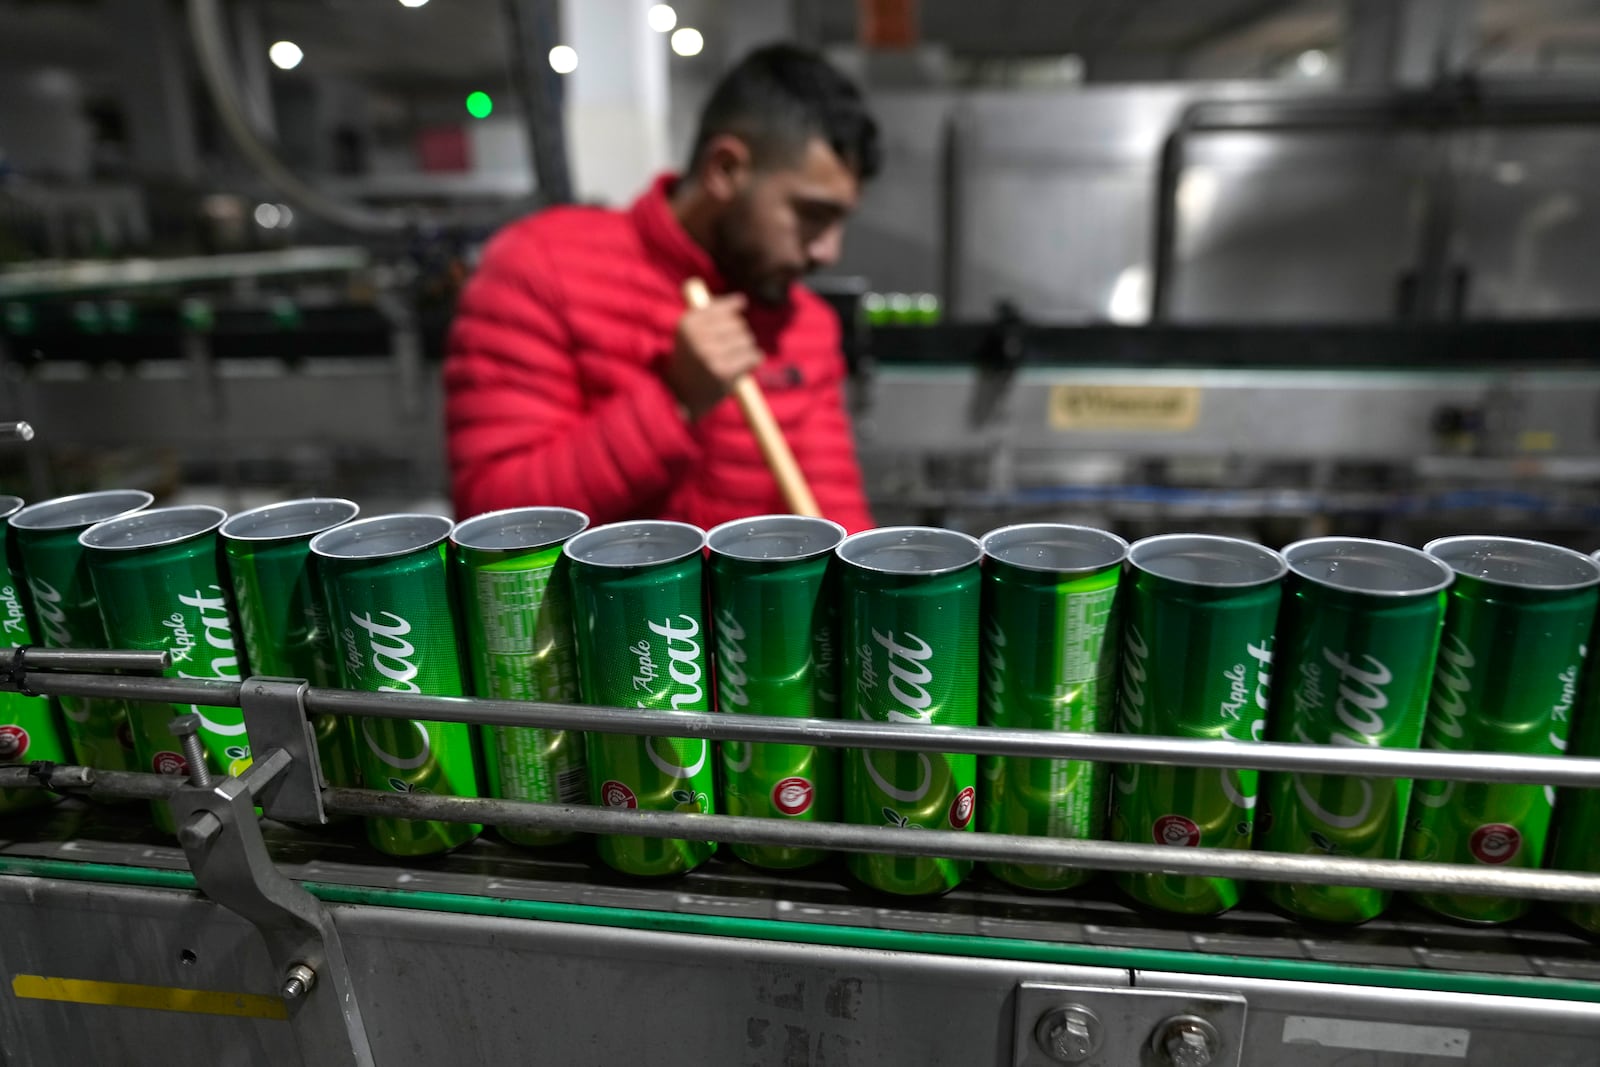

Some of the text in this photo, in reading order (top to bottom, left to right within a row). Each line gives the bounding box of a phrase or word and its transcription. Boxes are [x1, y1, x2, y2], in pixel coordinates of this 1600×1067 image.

[3, 585, 25, 634] Apple
[162, 612, 197, 662] Apple
[341, 627, 365, 681] Apple
[629, 639, 660, 694] Apple
[856, 643, 879, 701] Apple
[1220, 663, 1249, 721] Apple
